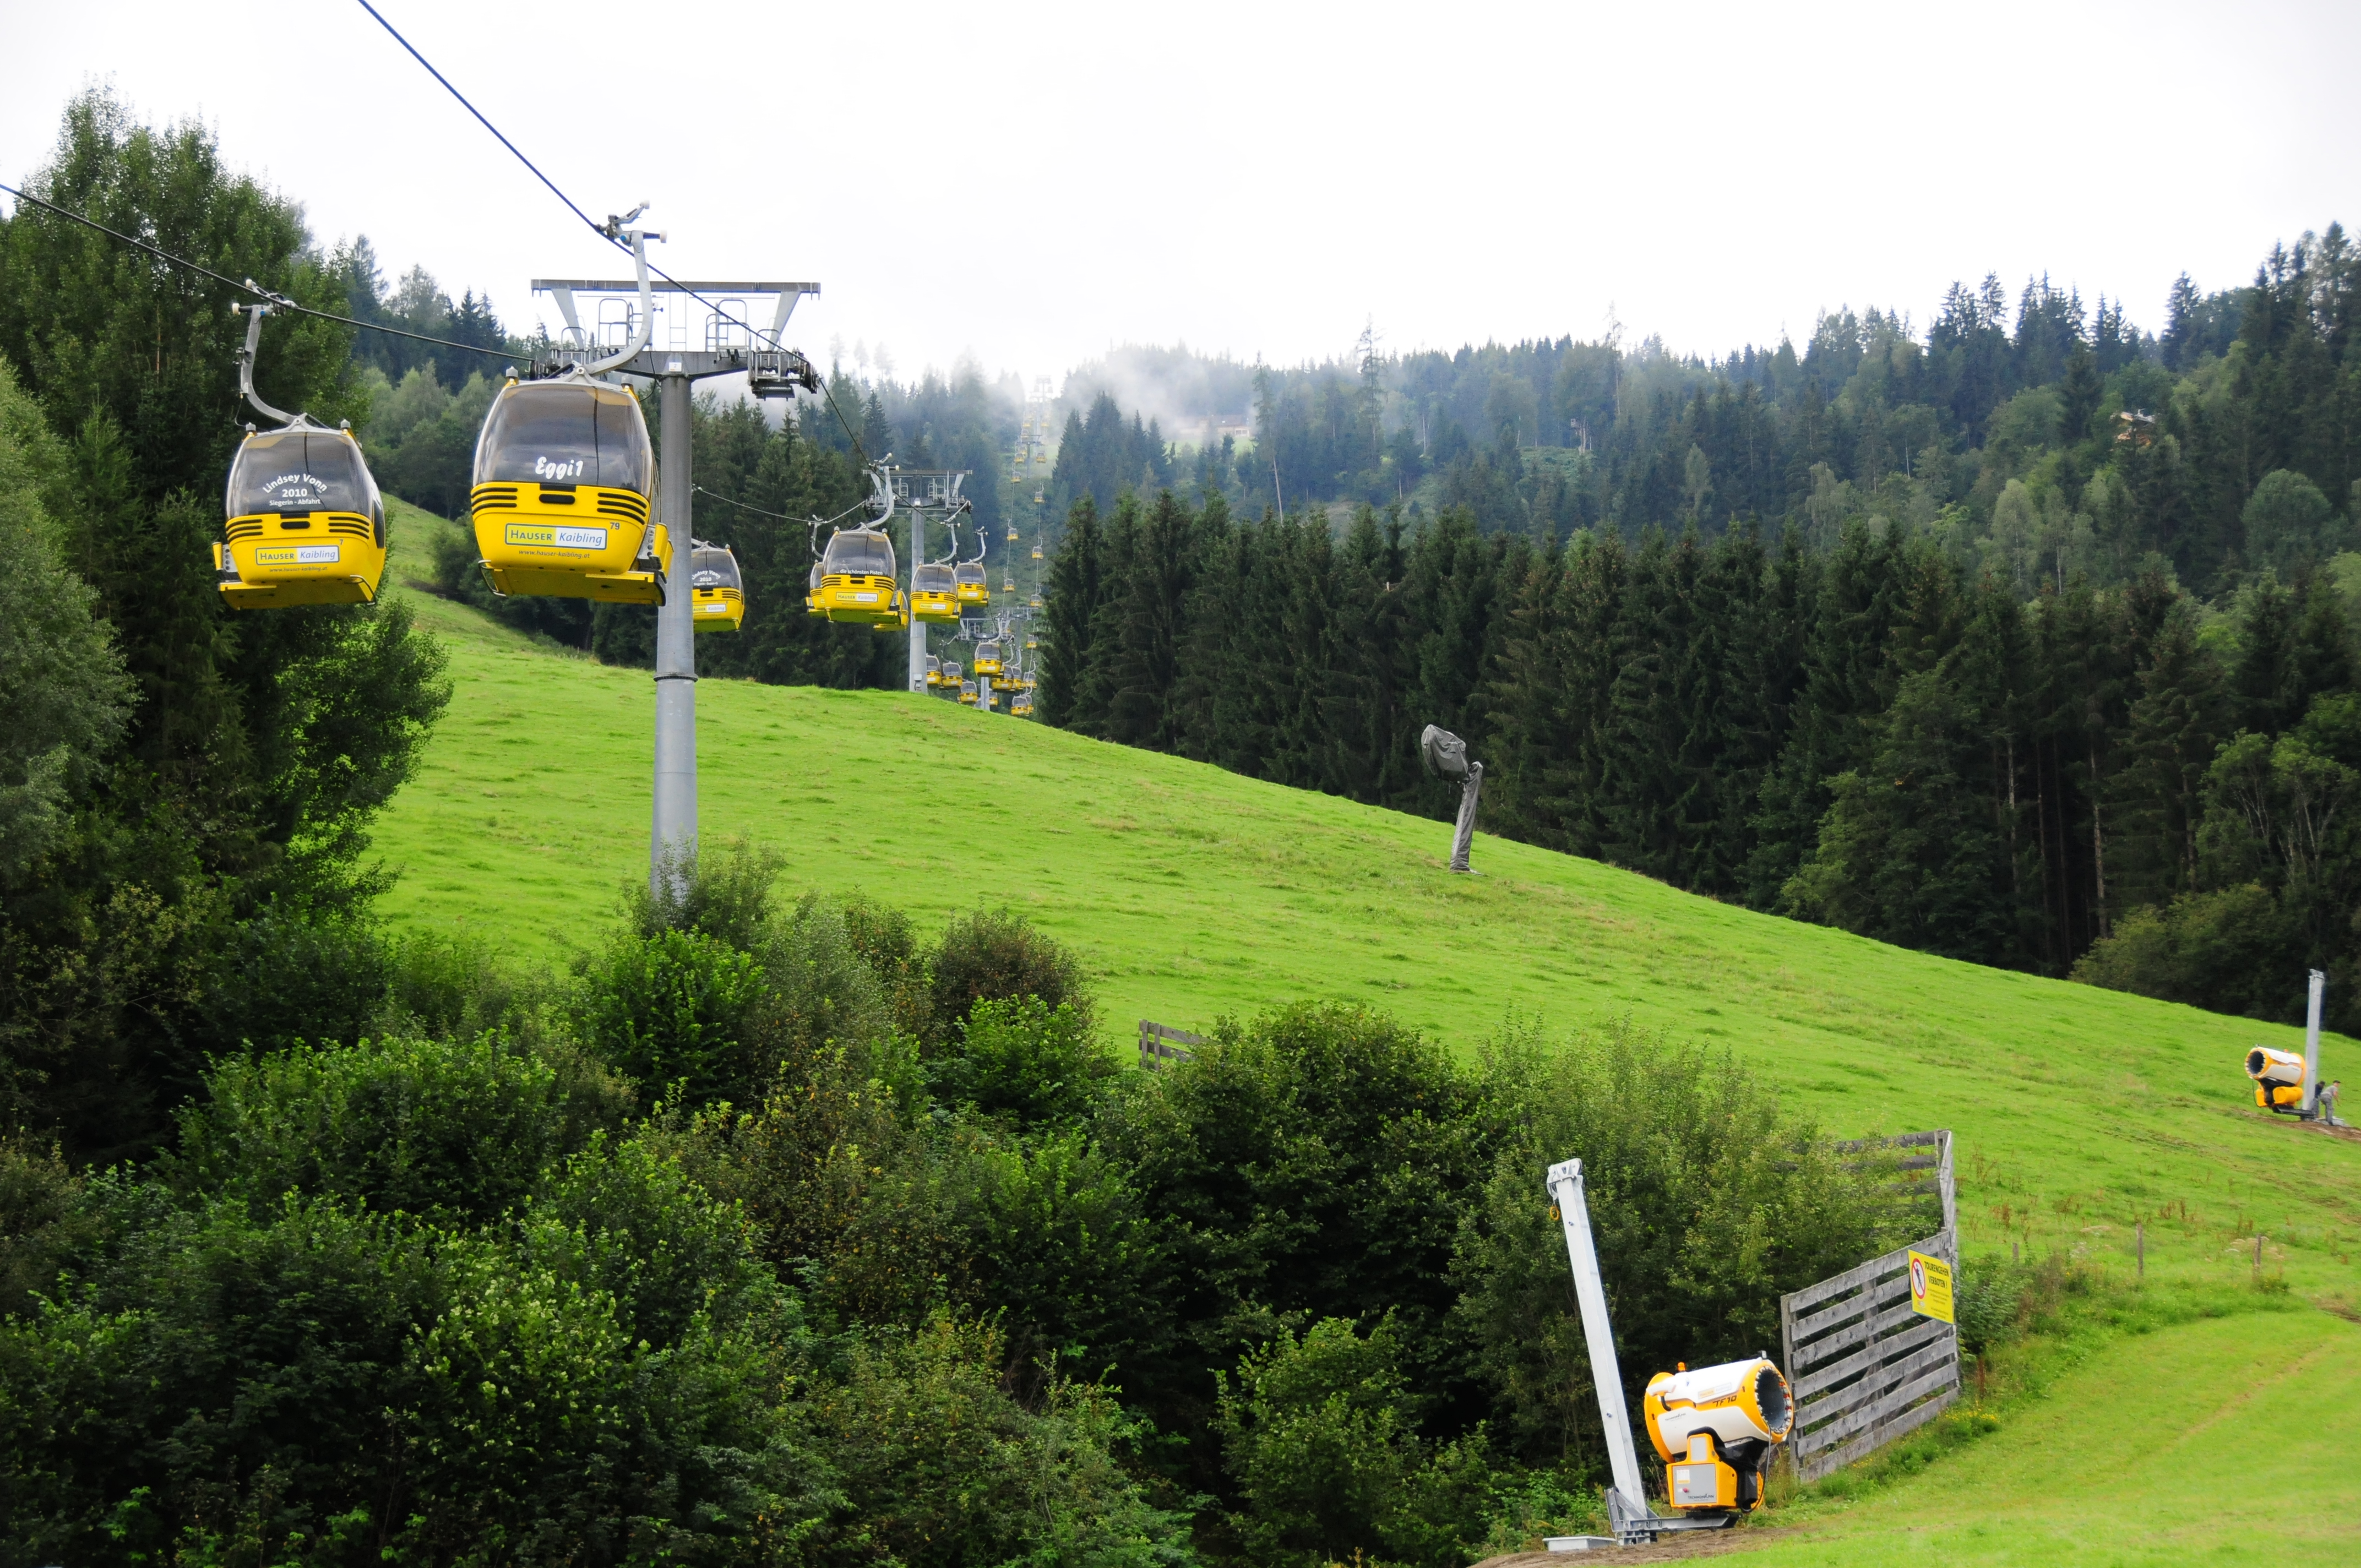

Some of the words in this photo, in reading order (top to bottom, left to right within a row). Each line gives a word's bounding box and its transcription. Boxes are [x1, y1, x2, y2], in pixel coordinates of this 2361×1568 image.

[262, 474, 301, 493] Lindsey
[303, 473, 328, 492] Vonn
[282, 488, 308, 497] 2010
[269, 499, 293, 507] Siegerin
[610, 522, 621, 530] 79
[510, 530, 553, 541] HAUSER
[559, 532, 603, 546] Kaibling
[260, 552, 295, 560] HAUSER
[300, 550, 336, 560] Kaibling
[519, 550, 590, 559] www.hauser-kaibling.at
